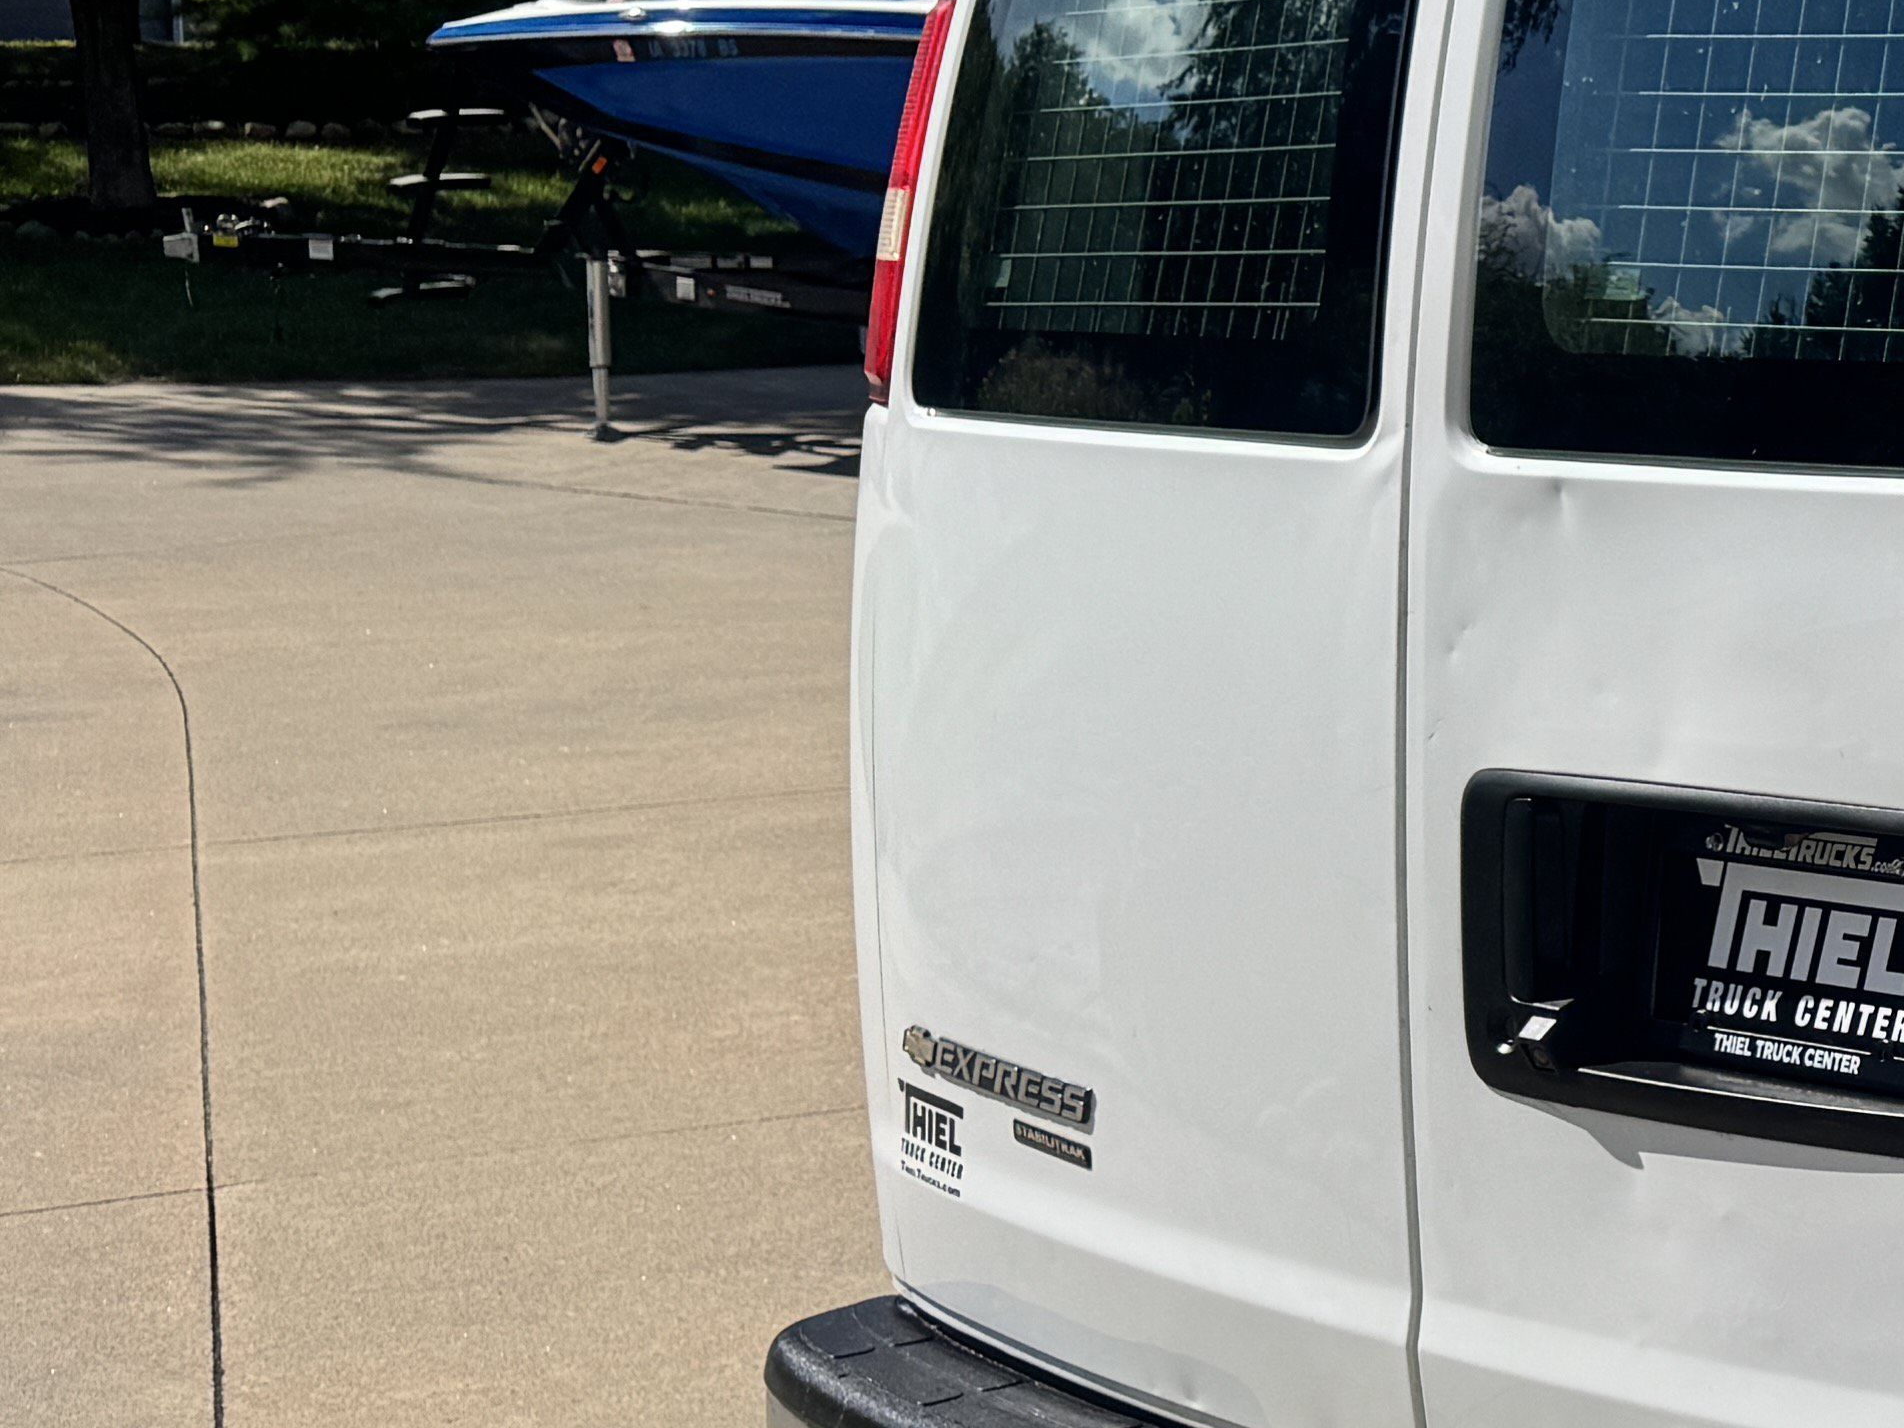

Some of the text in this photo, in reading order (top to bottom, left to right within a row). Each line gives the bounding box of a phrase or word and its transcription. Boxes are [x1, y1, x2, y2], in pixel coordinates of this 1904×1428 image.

[1691, 977, 1783, 1022] TRUCK
[934, 1040, 1086, 1123] EXPRESS
[1713, 1033, 1861, 1075] THIEL TRUCK CENTER
[897, 1077, 964, 1157] THIEL
